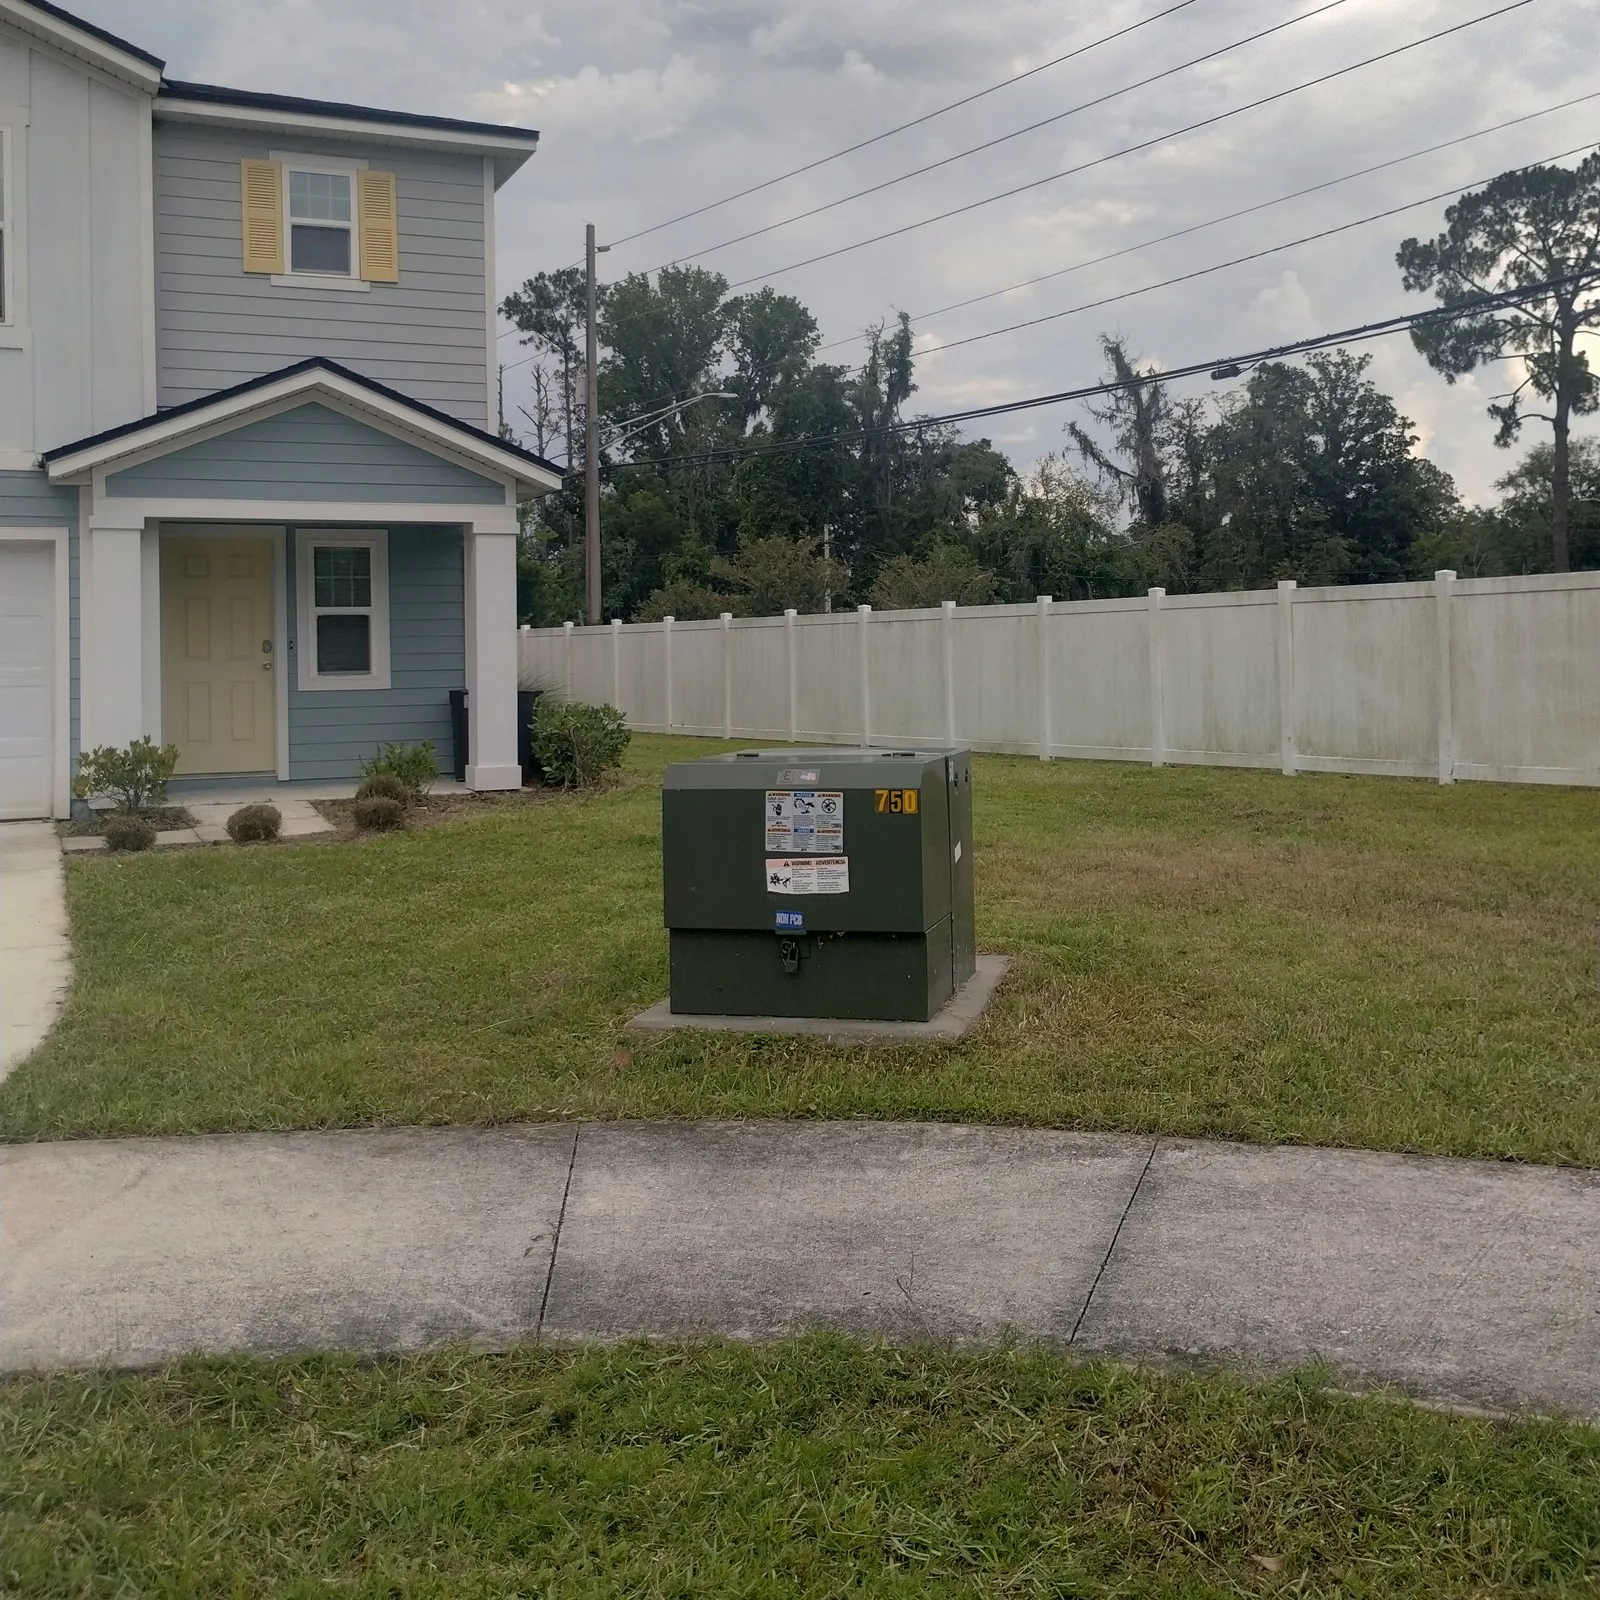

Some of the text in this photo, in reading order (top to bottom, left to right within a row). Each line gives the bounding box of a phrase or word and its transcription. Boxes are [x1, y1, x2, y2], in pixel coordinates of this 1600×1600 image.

[875, 789, 916, 812] 750
[776, 912, 803, 926] NON PCB
